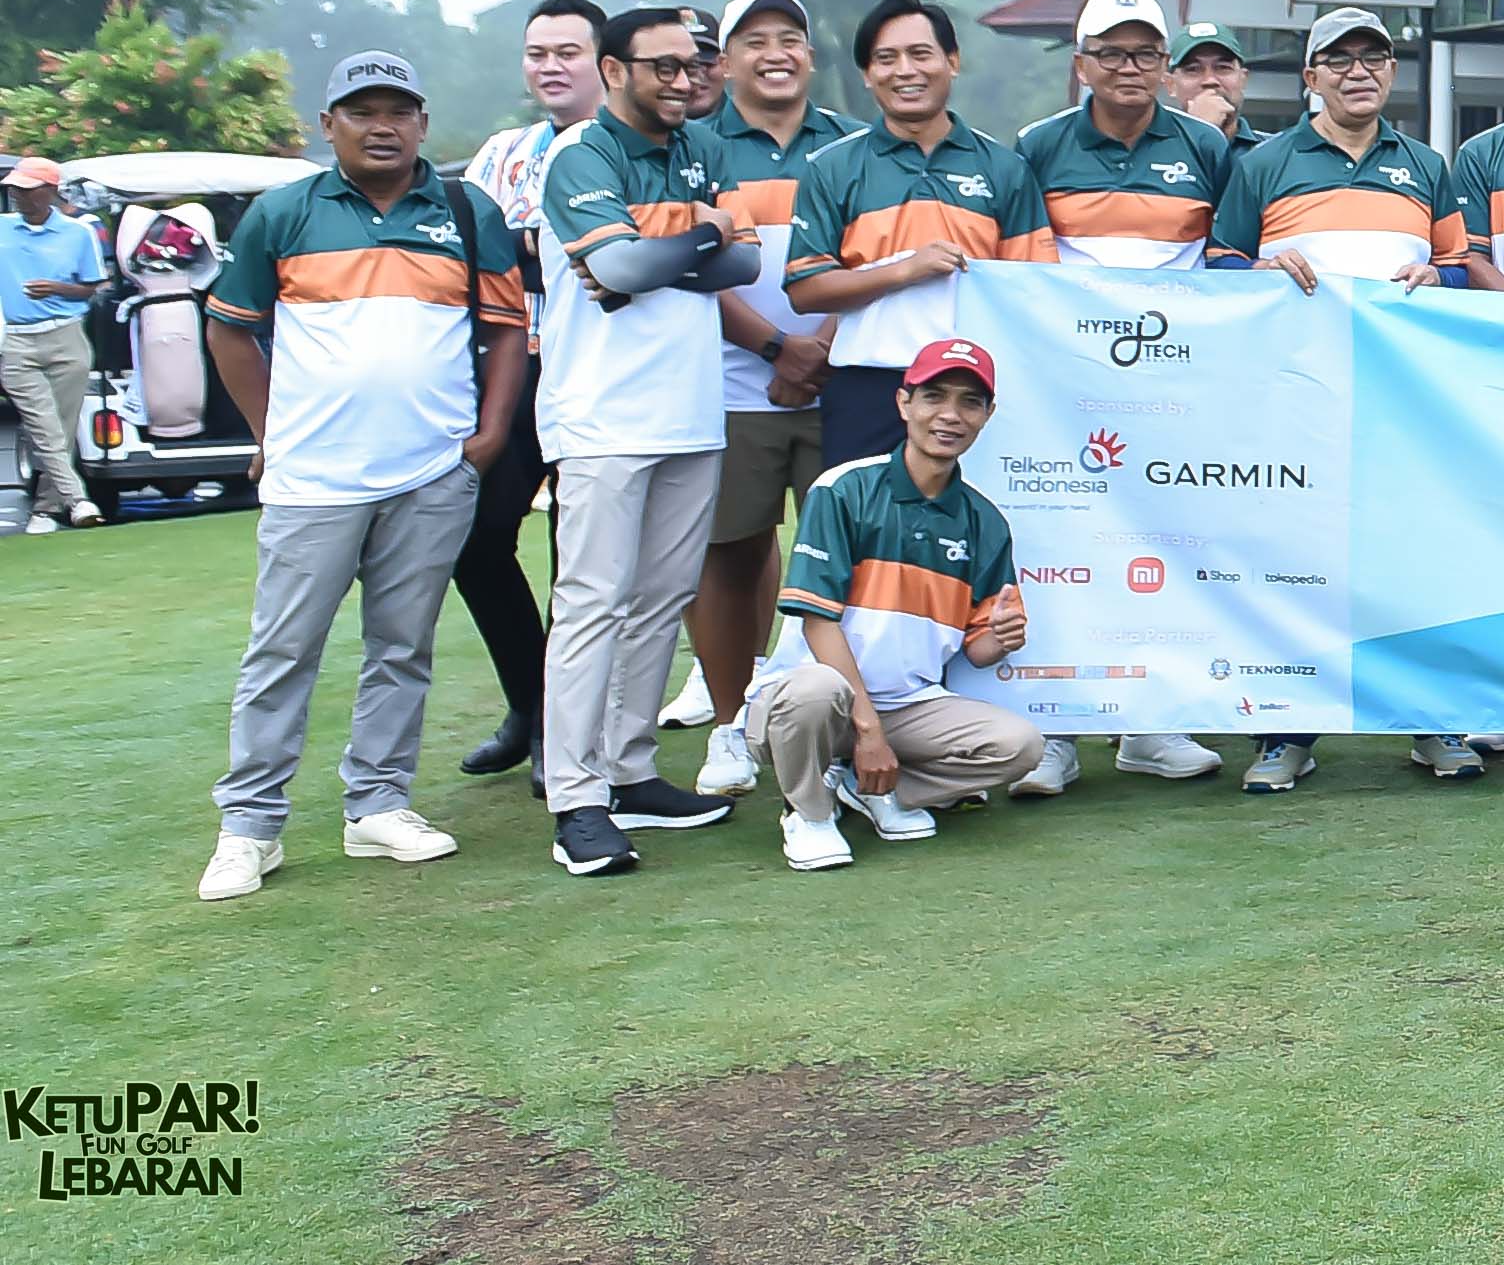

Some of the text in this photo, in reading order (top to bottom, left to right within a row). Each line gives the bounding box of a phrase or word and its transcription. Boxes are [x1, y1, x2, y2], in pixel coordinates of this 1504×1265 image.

[347, 63, 408, 82] PING
[1076, 319, 1133, 335] HYPER
[1143, 344, 1190, 359] TECH
[1000, 456, 1073, 473] Telkom
[1008, 476, 1108, 493] Indonesia
[1019, 567, 1091, 584] NIKO
[1209, 569, 1327, 586] Shop tokopedia
[1238, 664, 1317, 676] TEKNOBUZZ
